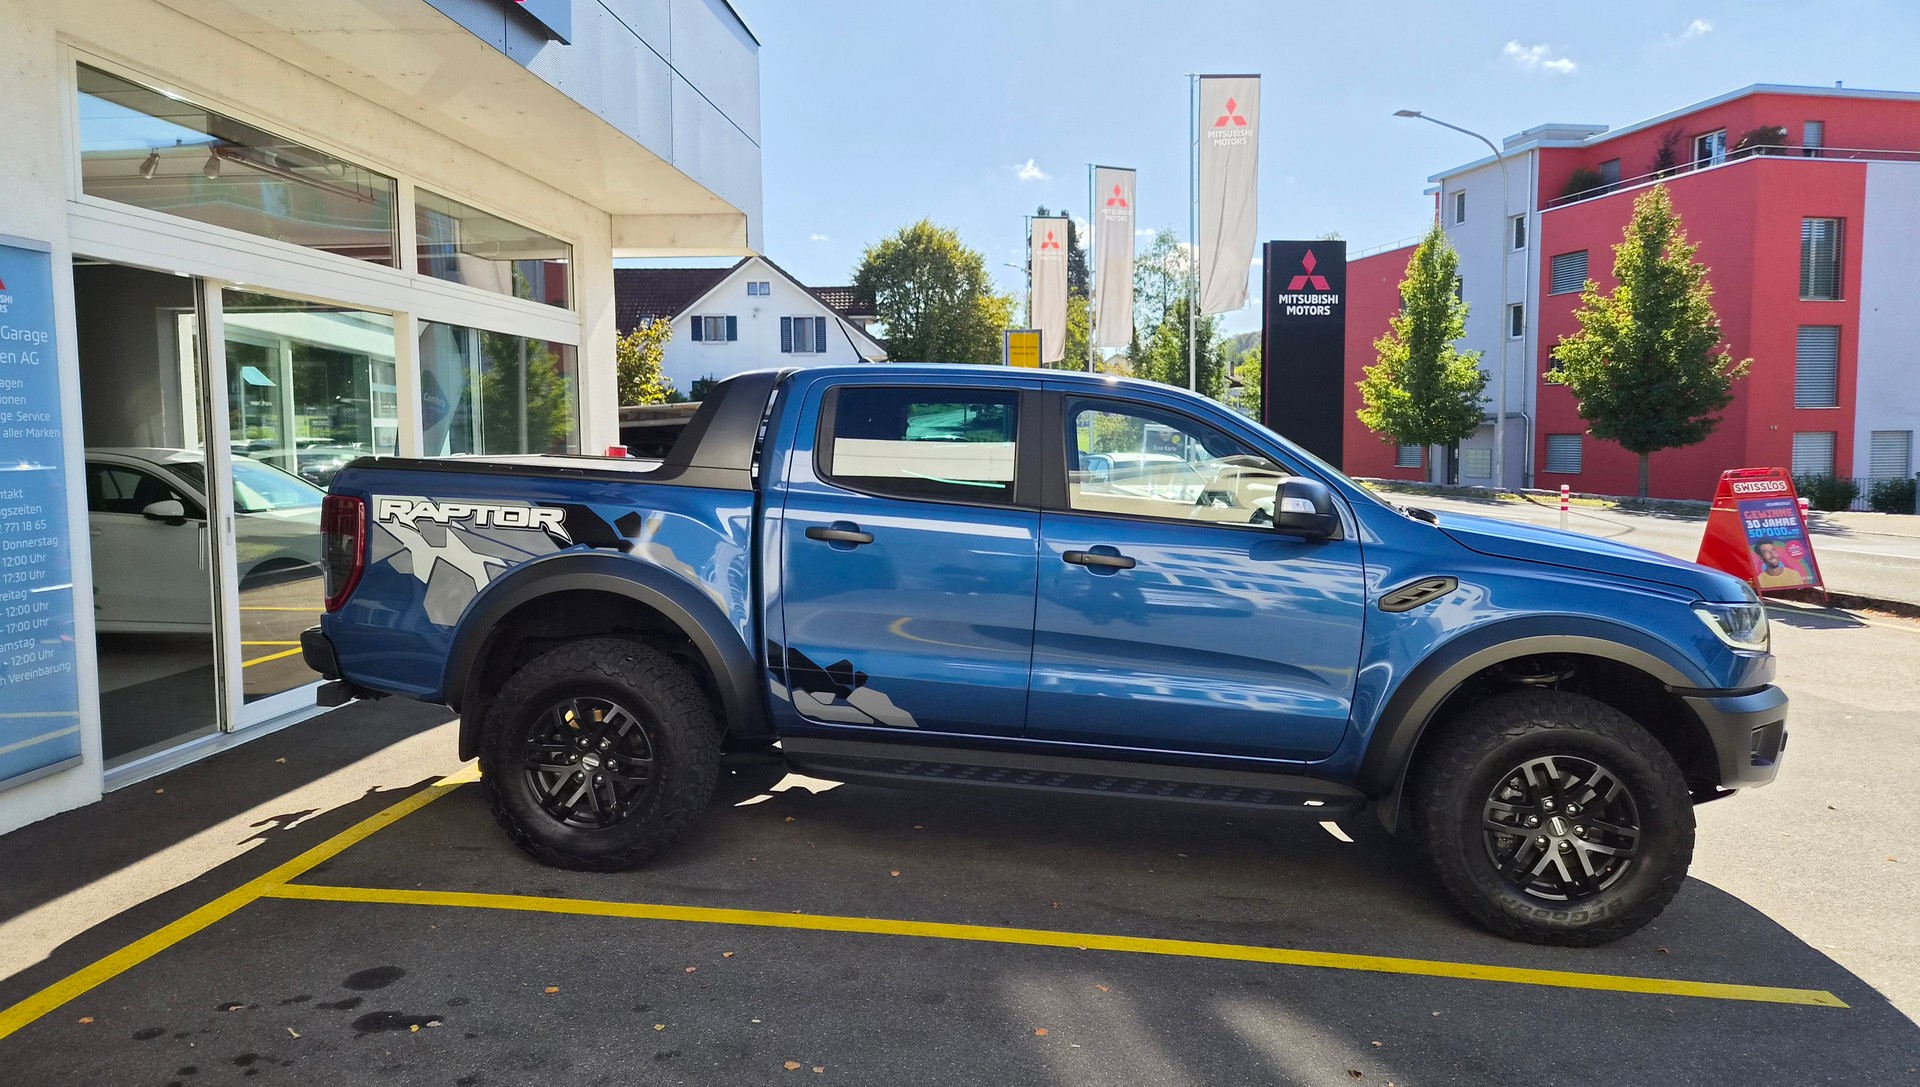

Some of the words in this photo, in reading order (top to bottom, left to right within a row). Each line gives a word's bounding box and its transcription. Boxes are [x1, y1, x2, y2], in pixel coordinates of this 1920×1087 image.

[1208, 129, 1253, 139] MITSUBISHI
[1213, 137, 1248, 146] MOTORS
[1101, 208, 1133, 216] MITSUBISHI
[1278, 294, 1339, 305] MITSUBISHI
[1285, 305, 1331, 316] MOTORS
[1, 325, 48, 346] Garage
[20, 351, 39, 365] AG
[16, 411, 51, 422] Service
[2, 428, 24, 438] aller
[25, 427, 61, 438] Marken
[1734, 481, 1786, 492] SWISSLOS
[0, 504, 42, 519] gszeiten
[1743, 508, 1794, 519] GEWINNE
[4, 522, 20, 533] 771
[21, 521, 33, 531] 18
[35, 519, 47, 530] 65
[379, 499, 573, 546] RAPTOR
[1745, 519, 1762, 529] 30
[1762, 517, 1797, 528] JAHRE
[3, 536, 58, 551] Donnerstag
[2, 554, 28, 567] 12:00
[29, 553, 47, 564] Uhr
[3, 571, 27, 584] 17:30
[29, 569, 46, 580] Uhr
[5, 603, 31, 618] 12:00
[32, 601, 50, 613] Uhr
[6, 620, 31, 634] 17:00
[32, 617, 49, 629] Uhr
[11, 652, 36, 667] 12:00
[38, 649, 55, 661] Uhr
[8, 662, 71, 684] Vereinbarung
